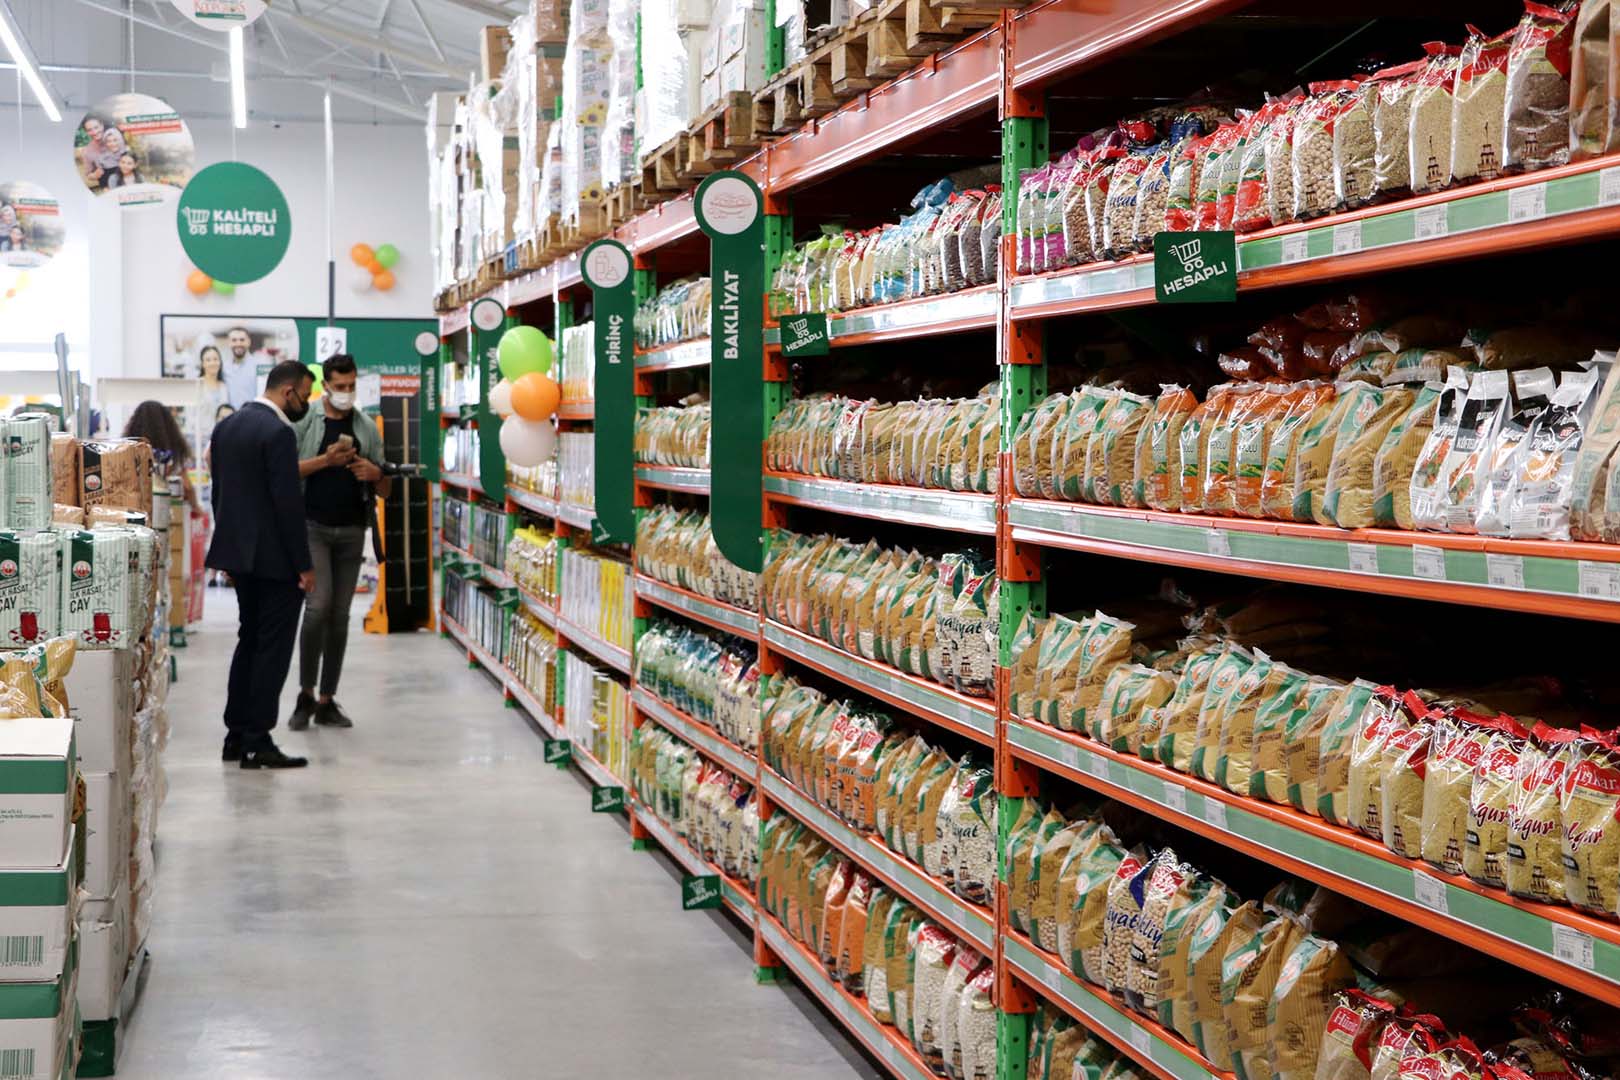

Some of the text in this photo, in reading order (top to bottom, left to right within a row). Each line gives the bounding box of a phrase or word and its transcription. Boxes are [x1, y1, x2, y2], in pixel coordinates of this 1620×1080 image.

[212, 207, 277, 224] KALİTELİ
[213, 222, 276, 236] HESAPLI
[1163, 261, 1228, 295] HESAPLI
[723, 270, 740, 360] BAKLİYAT
[320, 337, 329, 354] 2
[334, 339, 343, 356] 2
[608, 314, 624, 364] PİRİNÇ
[785, 330, 824, 352] HESAPLI
